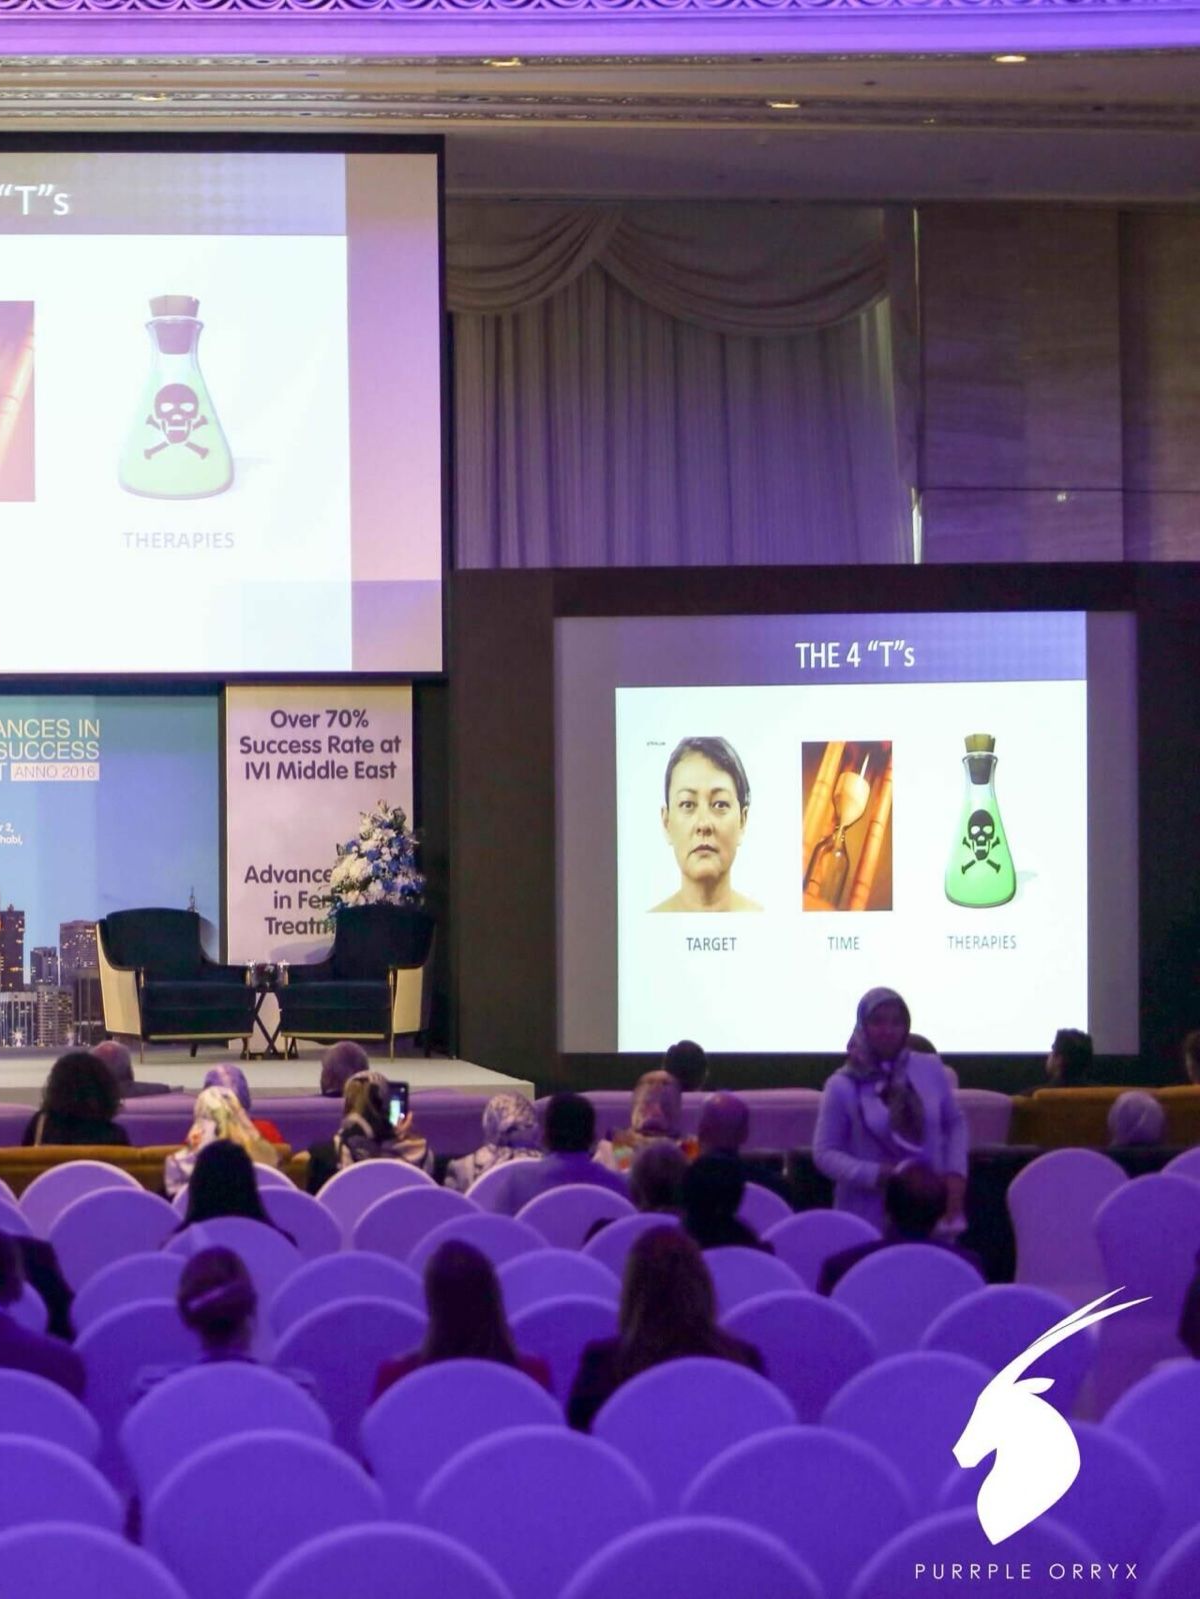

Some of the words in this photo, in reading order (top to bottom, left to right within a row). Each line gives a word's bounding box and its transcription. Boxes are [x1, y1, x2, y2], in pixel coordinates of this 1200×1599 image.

[122, 531, 236, 550] THERAPIES
[795, 642, 840, 669] THE
[846, 641, 861, 668] 4
[270, 710, 320, 728] Over
[326, 709, 369, 728] 70%
[79, 719, 100, 738] IN
[240, 736, 322, 754] Success
[327, 735, 374, 754] Rate
[380, 735, 401, 754] at
[13, 766, 58, 779] ANNO
[61, 766, 96, 779] 2016
[245, 761, 270, 780] IVI
[276, 760, 348, 779] Middle
[354, 761, 397, 779] East
[244, 865, 333, 884] Advance
[273, 891, 292, 909] in
[686, 937, 737, 952] TARGET
[828, 936, 860, 951] TIME
[947, 935, 1017, 950] THERAPIES
